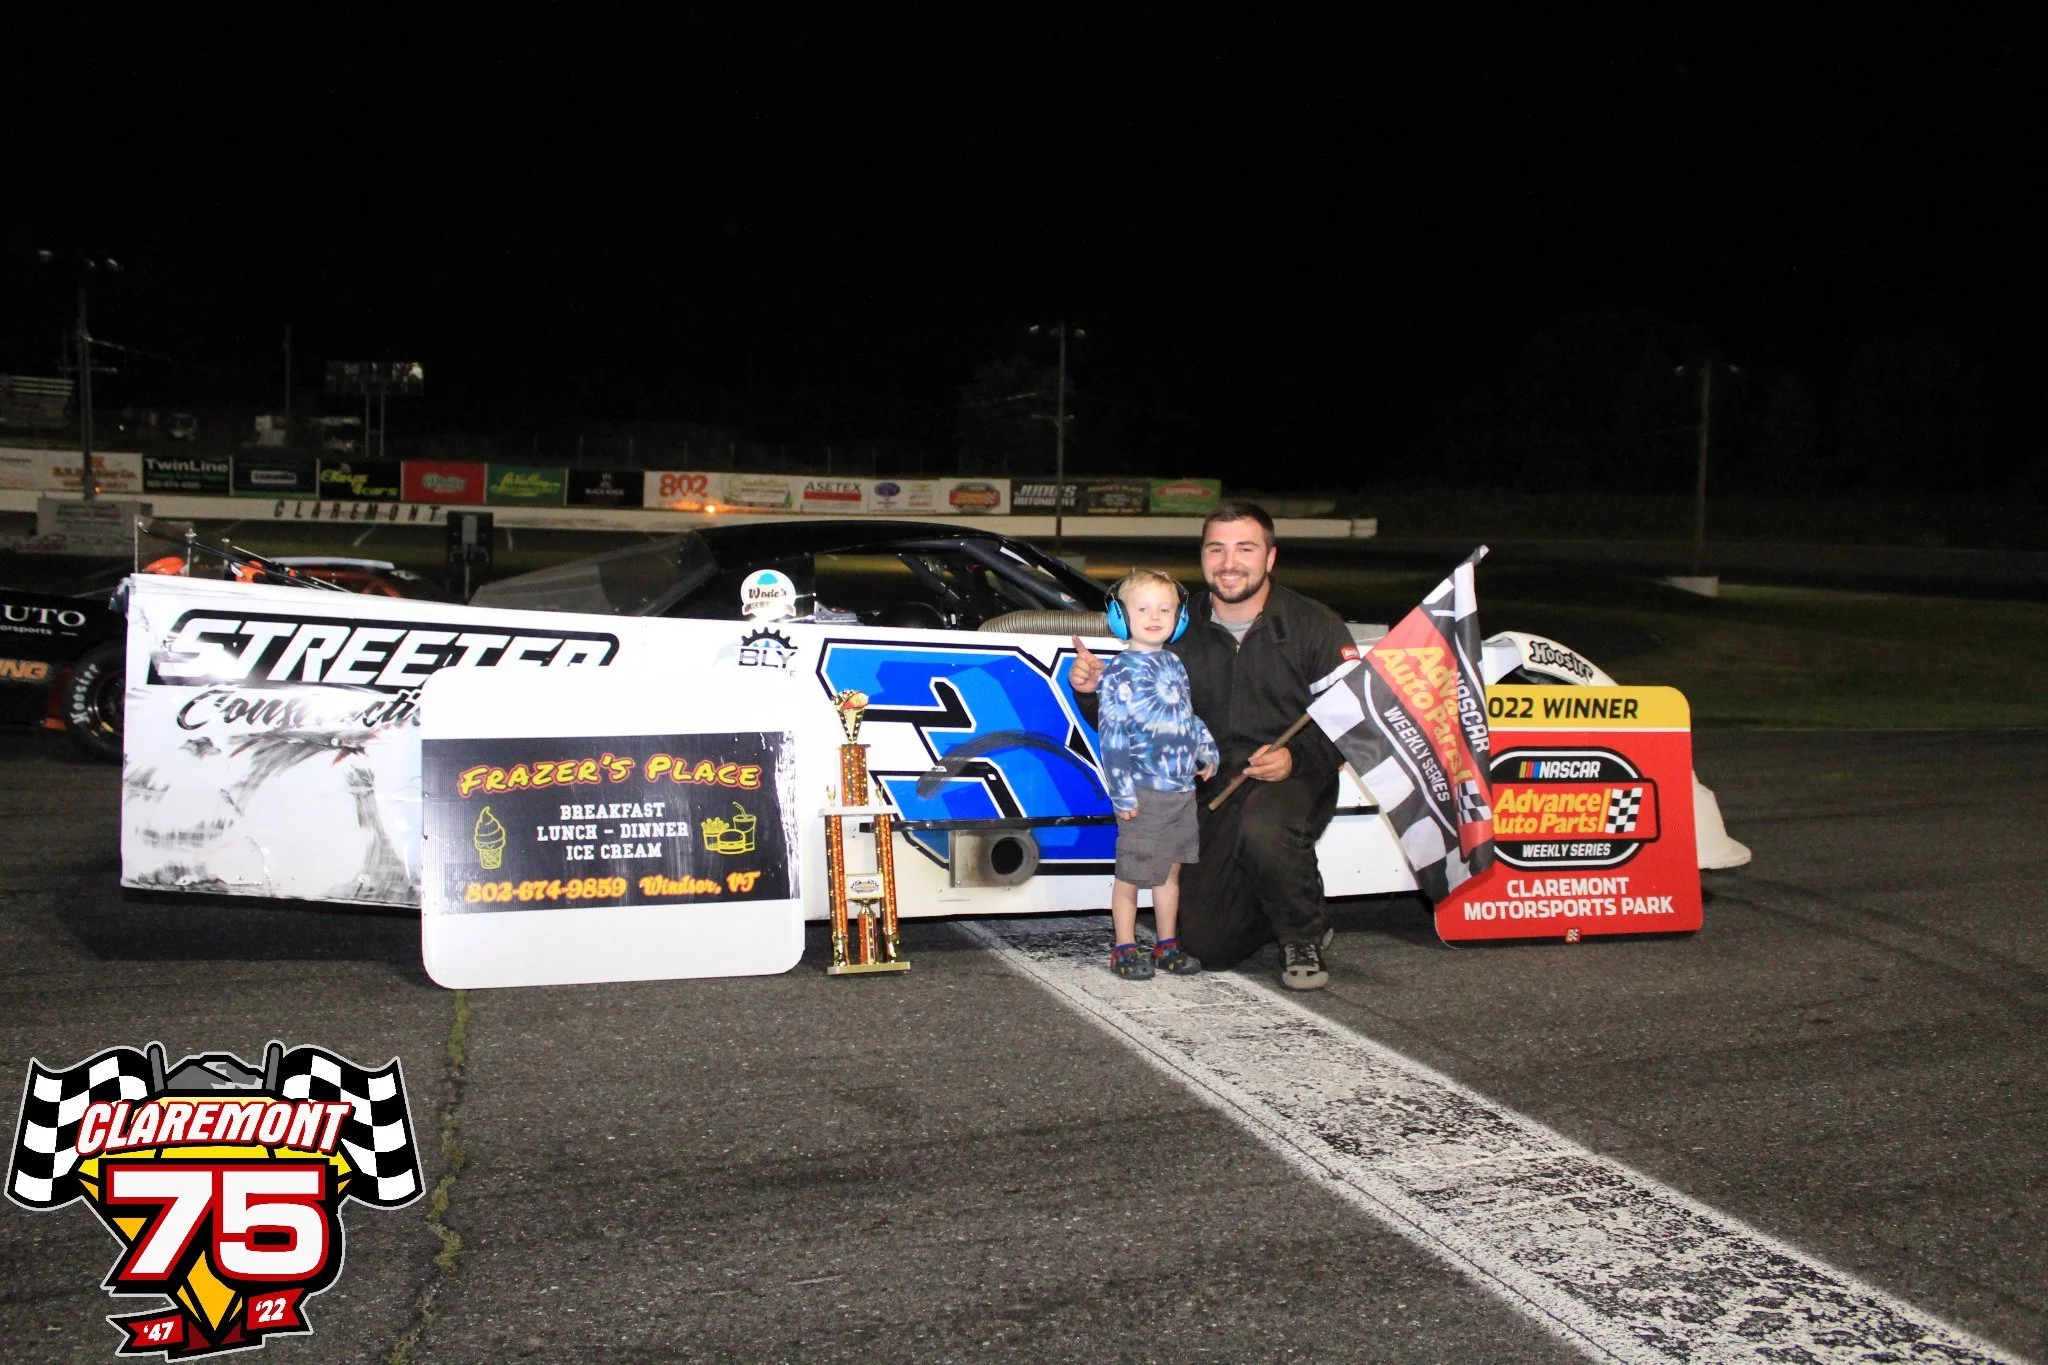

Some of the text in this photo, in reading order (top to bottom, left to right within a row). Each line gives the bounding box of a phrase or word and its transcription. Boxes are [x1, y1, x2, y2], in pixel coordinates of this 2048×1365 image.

[144, 458, 228, 473] TwinLine
[658, 474, 708, 498] 802
[805, 481, 862, 492] ASETEX
[273, 500, 441, 523] CLAREMONT
[0, 604, 86, 627] UTO
[1529, 641, 1594, 681] Hoosier
[1372, 649, 1434, 710] Auto
[1488, 697, 1639, 719] 022 WINNER
[816, 638, 1118, 875] 3
[1383, 706, 1450, 802] WEEKLY SERIES
[458, 754, 762, 797] FRAZER'S PLACE
[1539, 761, 1601, 779] NASCAR
[560, 802, 665, 820] BREAKFAST
[1493, 788, 1602, 814] Advance
[537, 824, 598, 841] LUNCH
[620, 822, 689, 839] DINNER
[1539, 813, 1599, 834] Parts
[566, 843, 662, 861] ICE CREAM
[1522, 843, 1611, 858] WEEKLY SERIES
[465, 871, 761, 903] 802-674-9859 Windsor, VT
[1507, 877, 1629, 898] CLAREMONT
[1464, 896, 1675, 921] MOTORSPORTS PARK
